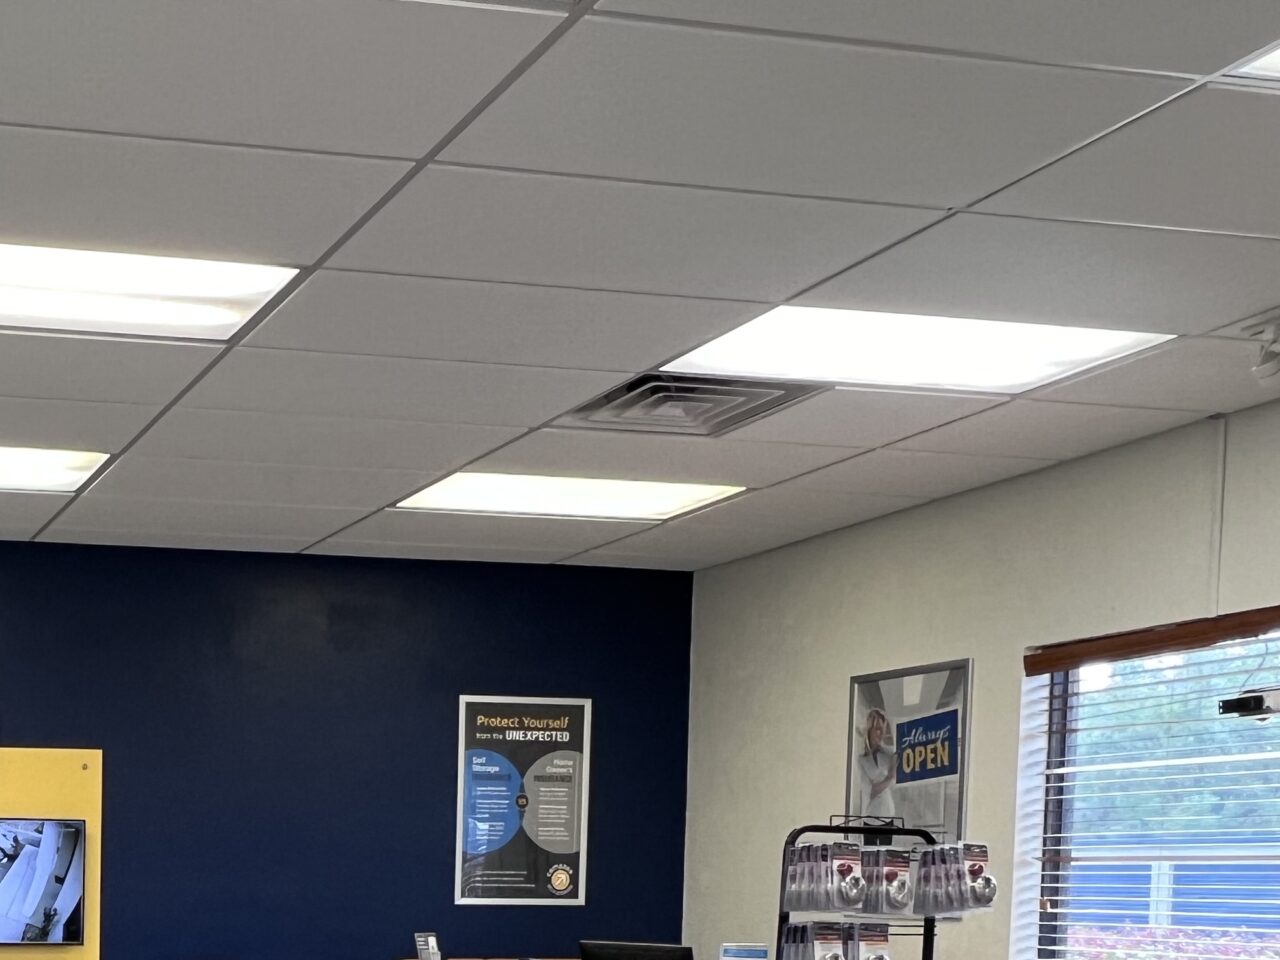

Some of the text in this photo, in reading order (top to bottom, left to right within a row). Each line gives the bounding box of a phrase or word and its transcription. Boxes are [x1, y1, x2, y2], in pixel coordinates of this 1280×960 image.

[476, 715, 570, 729] Protect Yourself
[505, 730, 570, 742] UNEXPECTED
[902, 741, 950, 773] OPEN
